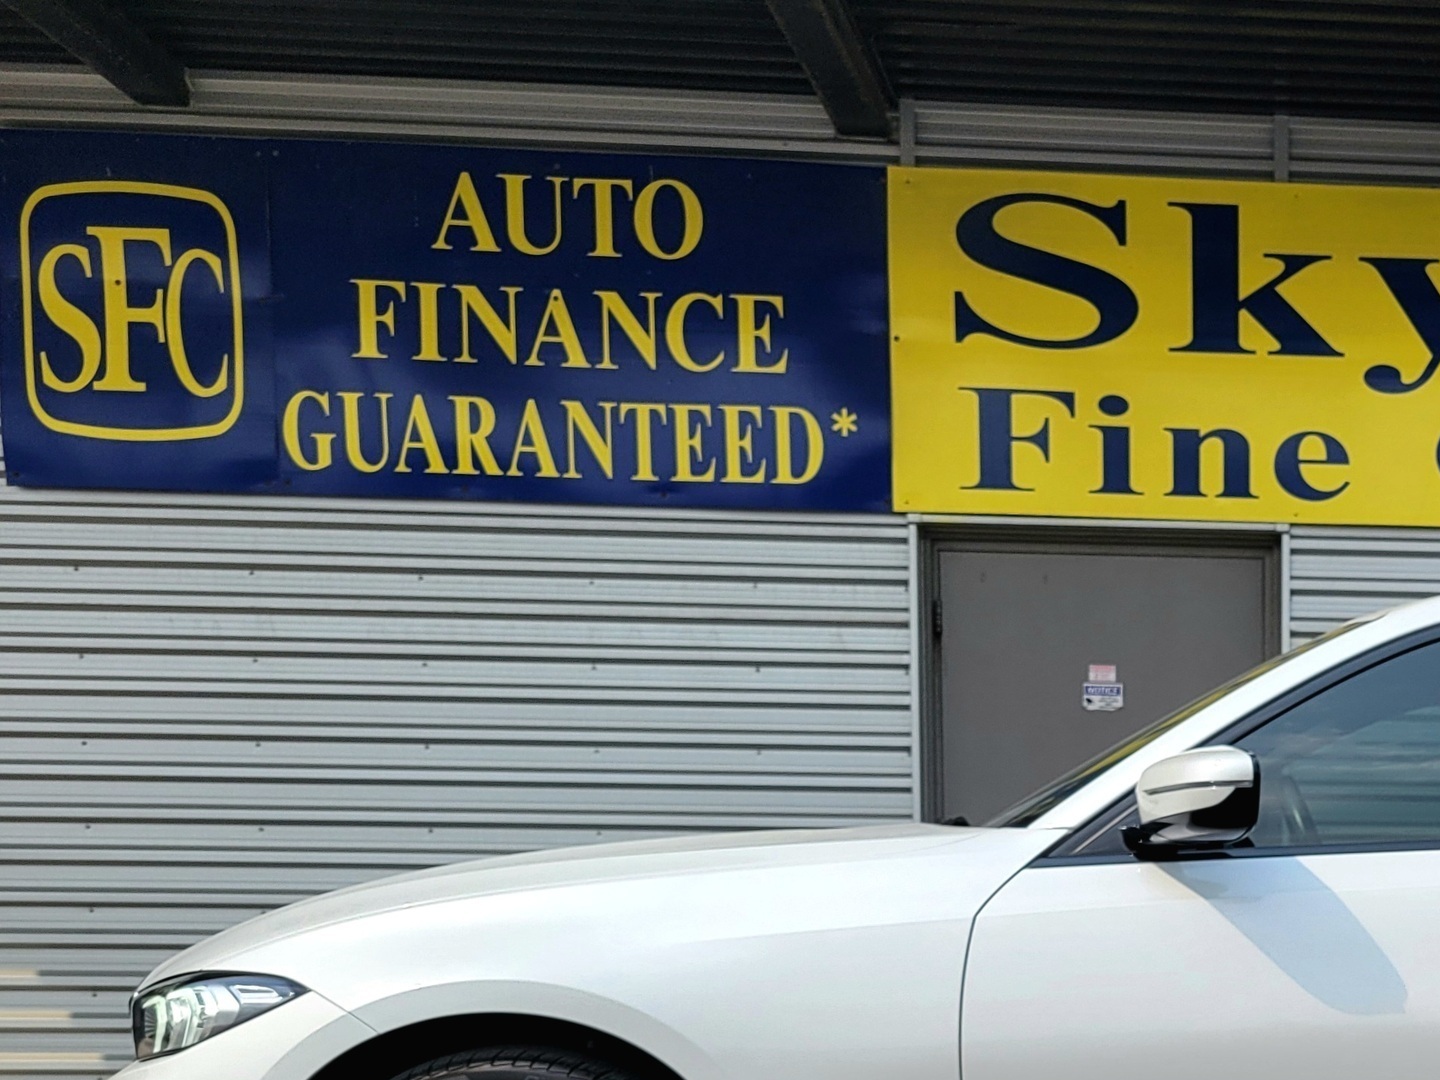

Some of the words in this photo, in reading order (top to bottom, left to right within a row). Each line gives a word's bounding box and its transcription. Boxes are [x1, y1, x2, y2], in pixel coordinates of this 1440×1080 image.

[431, 171, 704, 261] AUTO
[38, 225, 230, 397] SFC
[350, 278, 789, 374] FINANCE
[957, 386, 1351, 502] Fine
